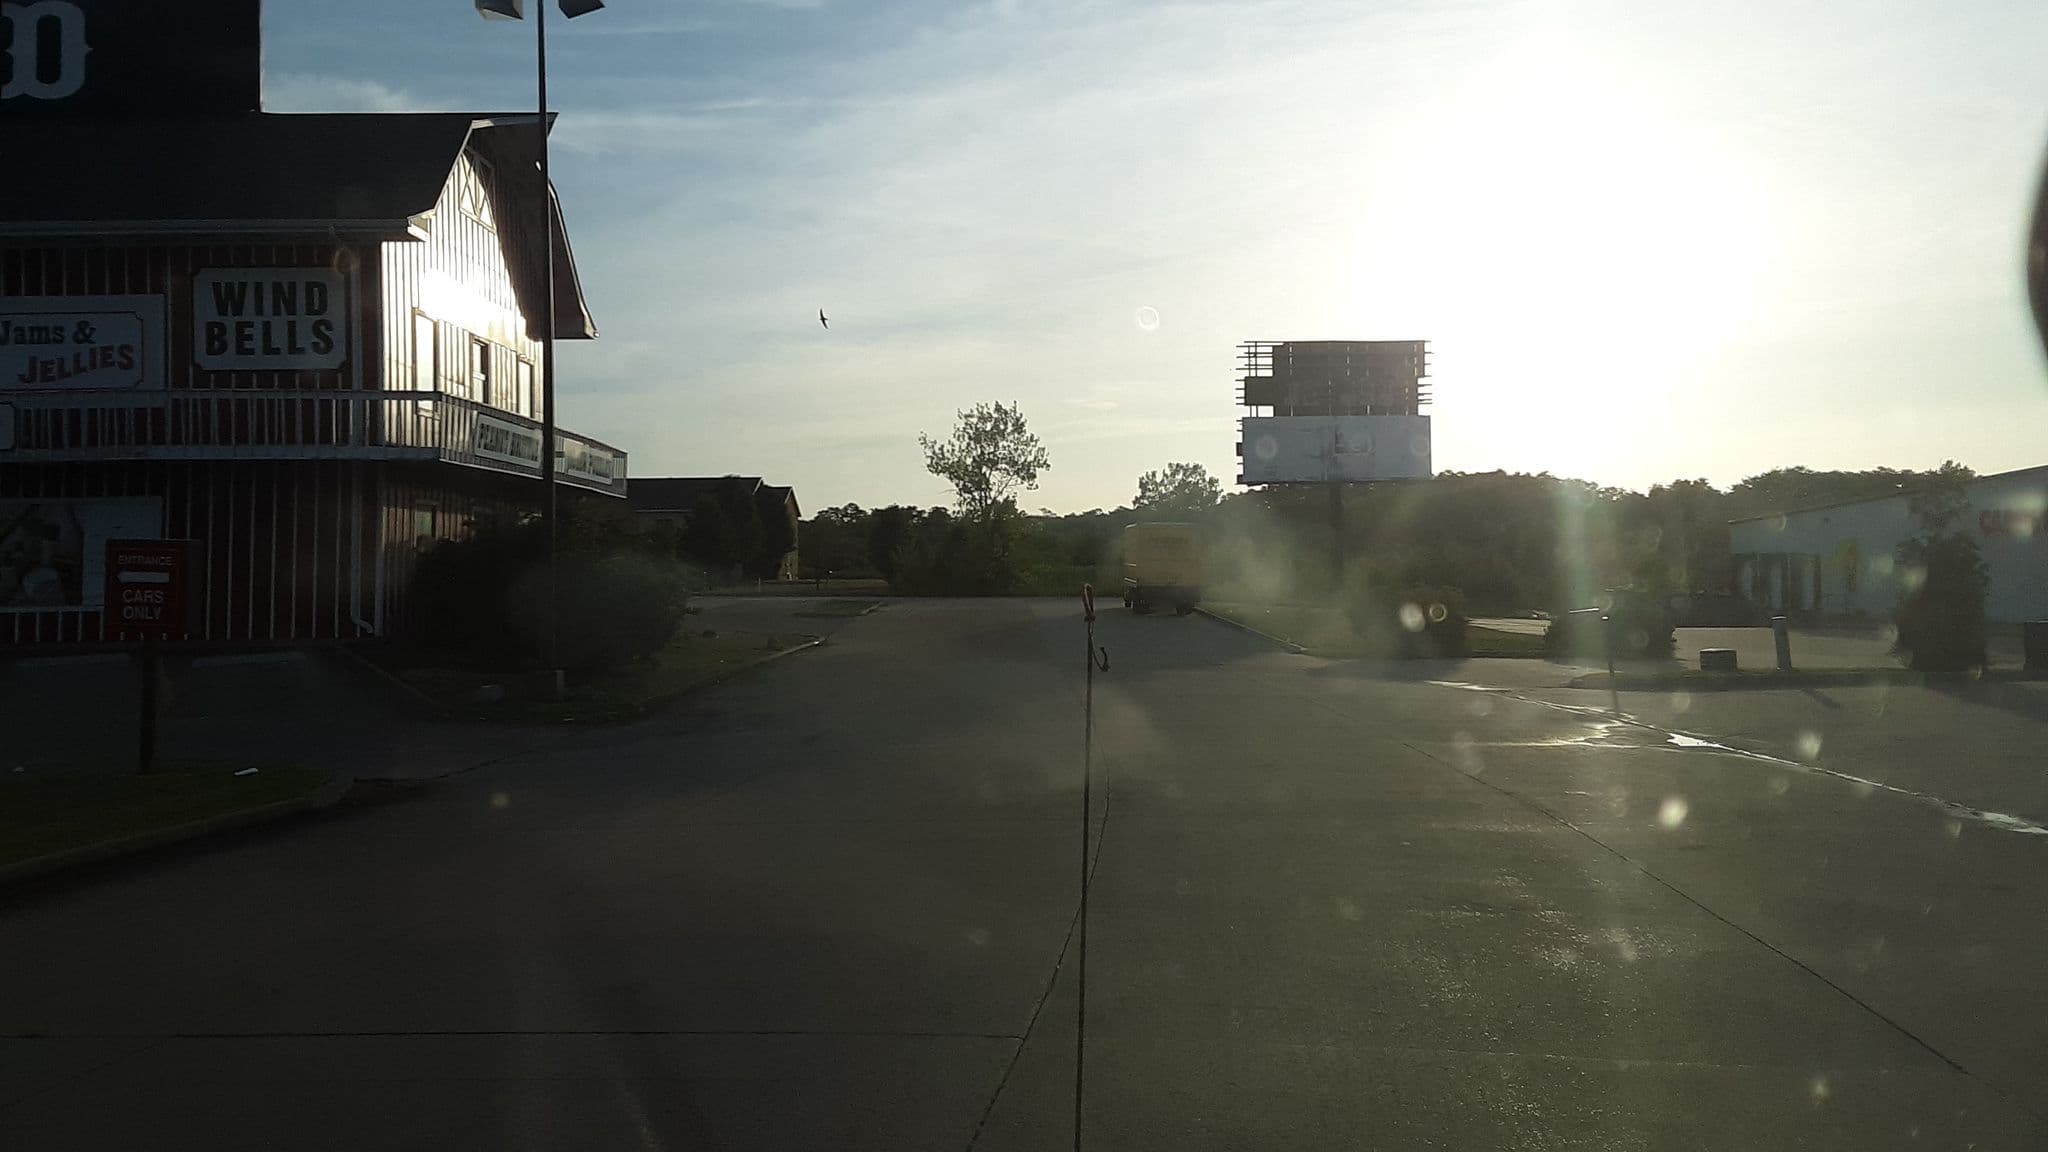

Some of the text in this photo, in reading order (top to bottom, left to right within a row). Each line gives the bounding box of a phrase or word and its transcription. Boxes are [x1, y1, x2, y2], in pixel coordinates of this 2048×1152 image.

[212, 281, 328, 316] WIND
[0, 320, 97, 346] Jams &
[206, 319, 334, 355] BELLS
[17, 343, 135, 383] JELLIES
[117, 555, 174, 567] ENTRANCE
[122, 589, 166, 604] CARS
[123, 606, 163, 620] ONLY
